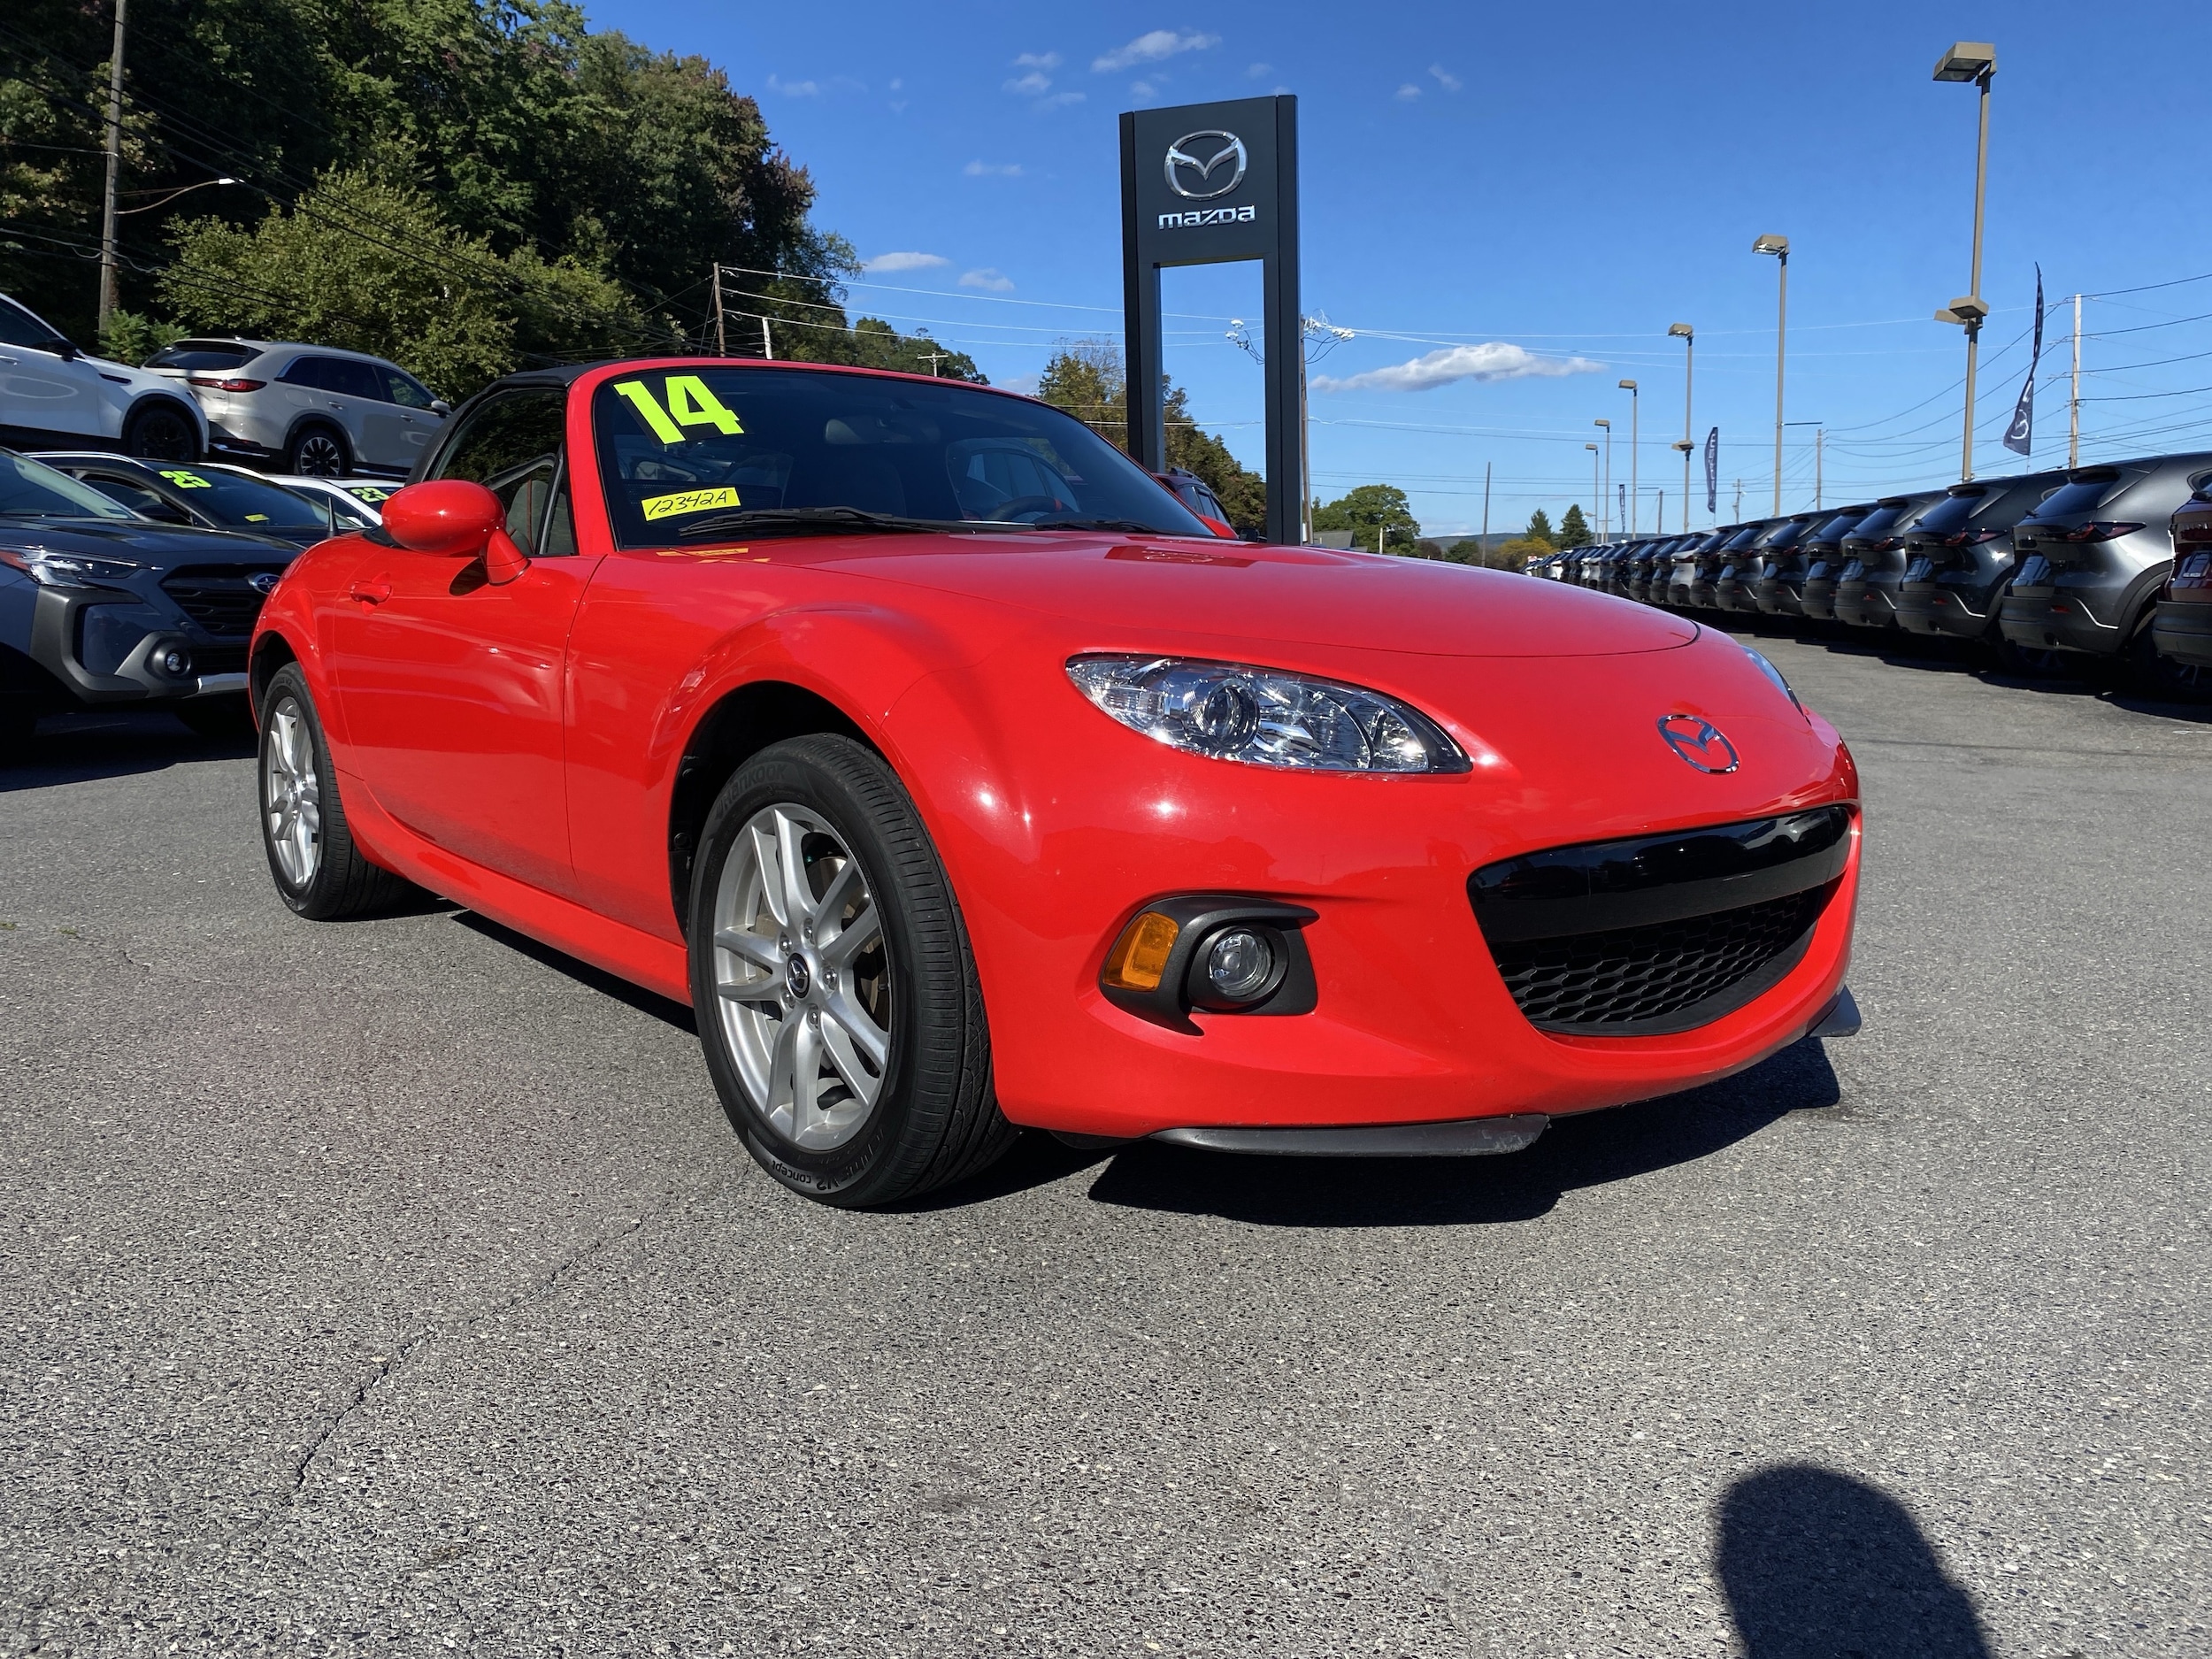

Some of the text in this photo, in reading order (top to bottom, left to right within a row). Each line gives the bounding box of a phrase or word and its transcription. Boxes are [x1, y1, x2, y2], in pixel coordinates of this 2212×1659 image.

[1158, 204, 1256, 230] mazda
[612, 375, 745, 444] 14
[159, 470, 212, 488] 25
[350, 487, 390, 503] 23
[649, 490, 727, 516] 12342A
